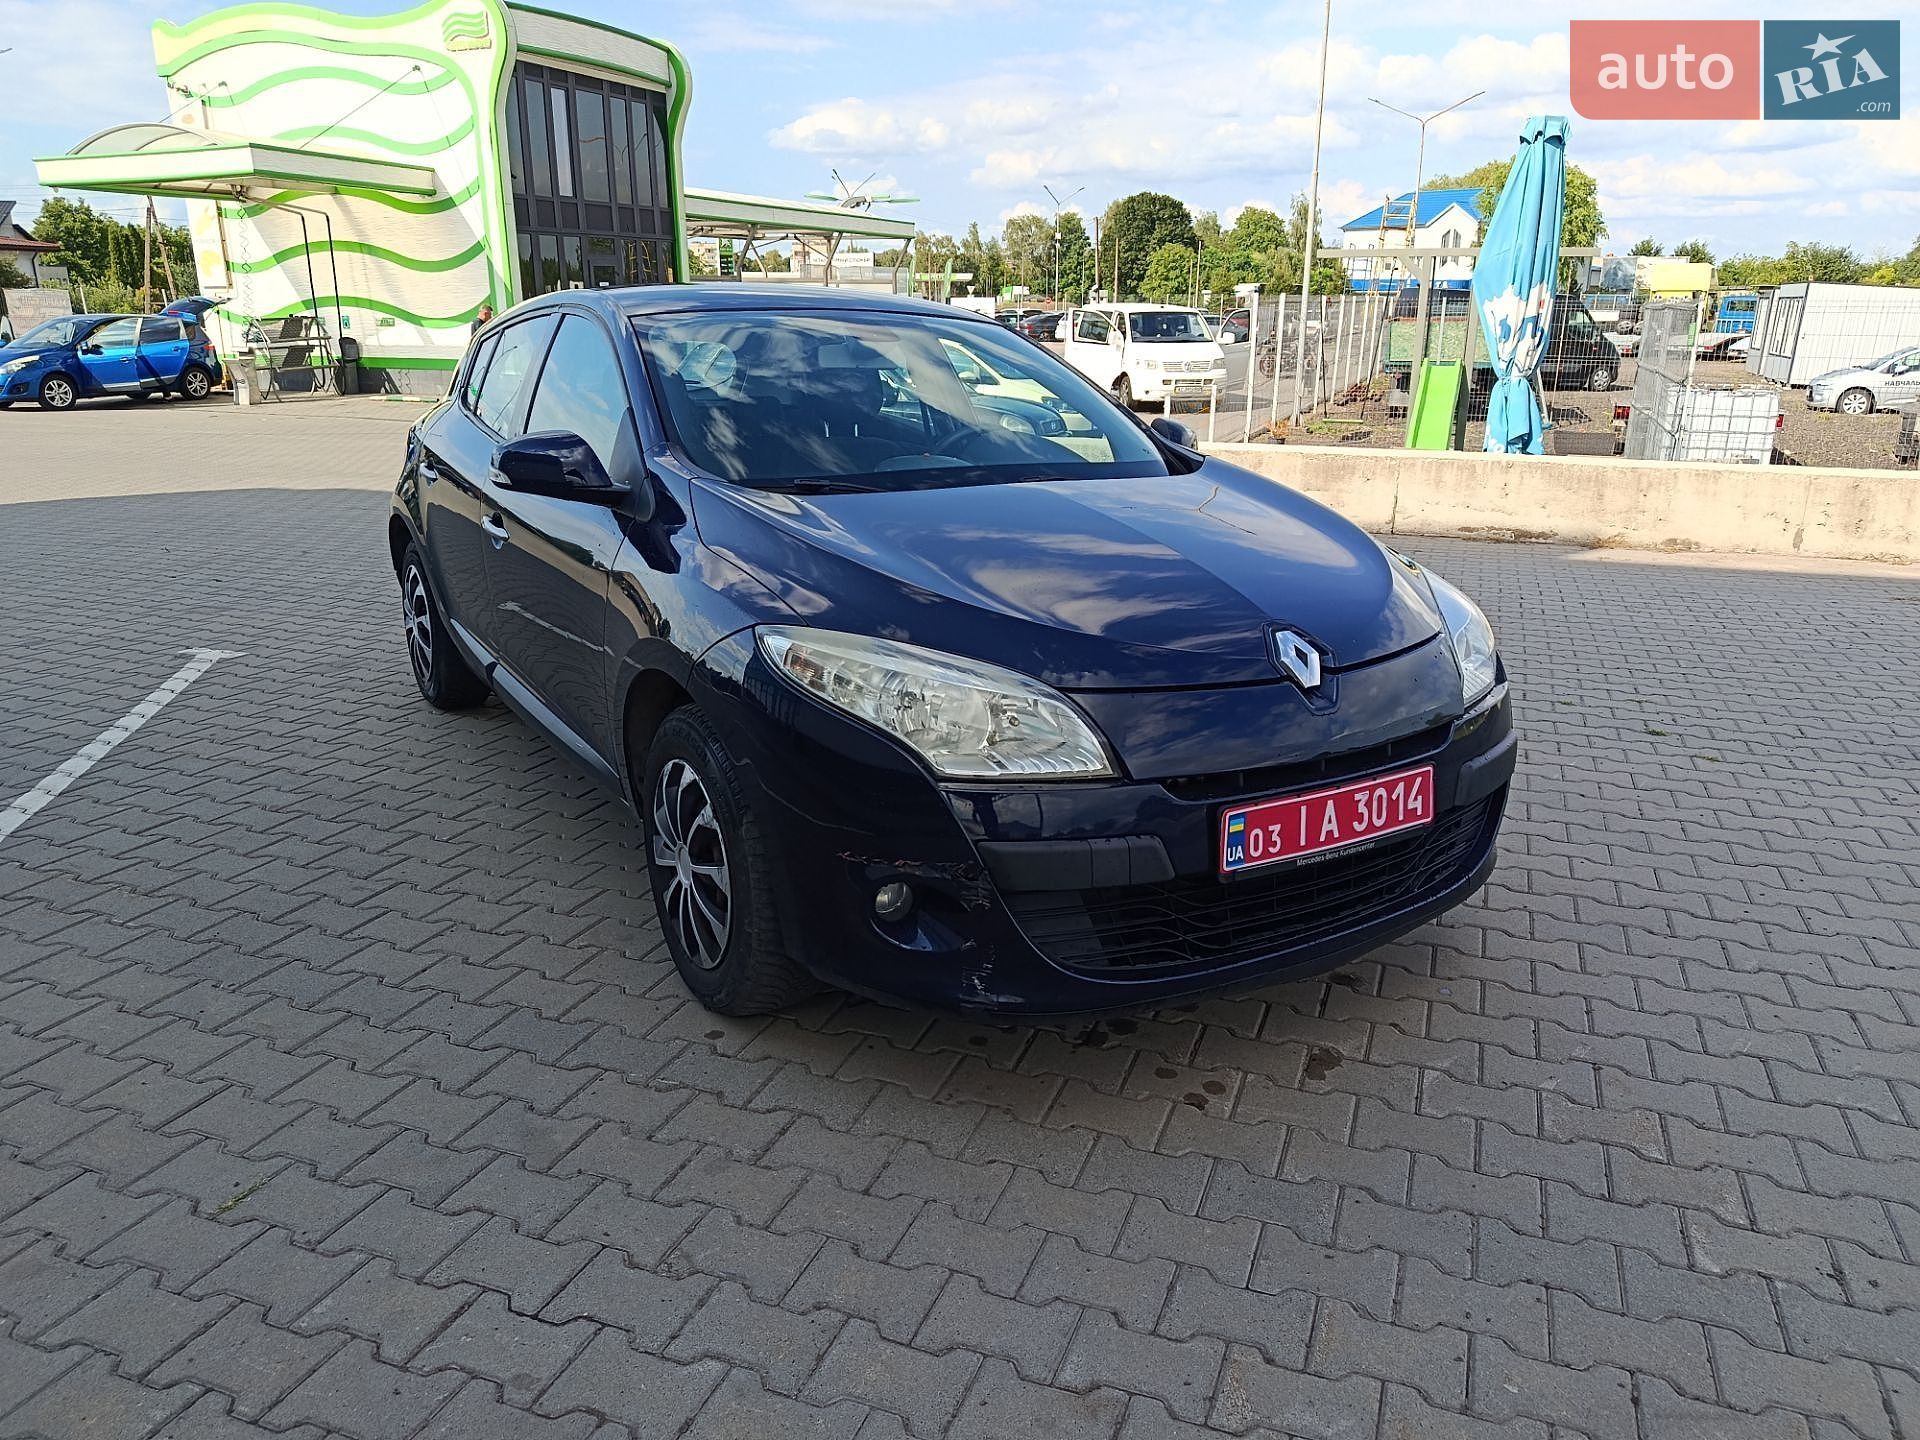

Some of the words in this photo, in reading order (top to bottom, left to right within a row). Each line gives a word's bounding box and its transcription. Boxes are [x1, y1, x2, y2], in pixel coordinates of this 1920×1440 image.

[1250, 824, 1282, 858] 03
[1300, 799, 1340, 846] IA
[1352, 776, 1423, 832] 3014
[1227, 846, 1244, 862] UA
